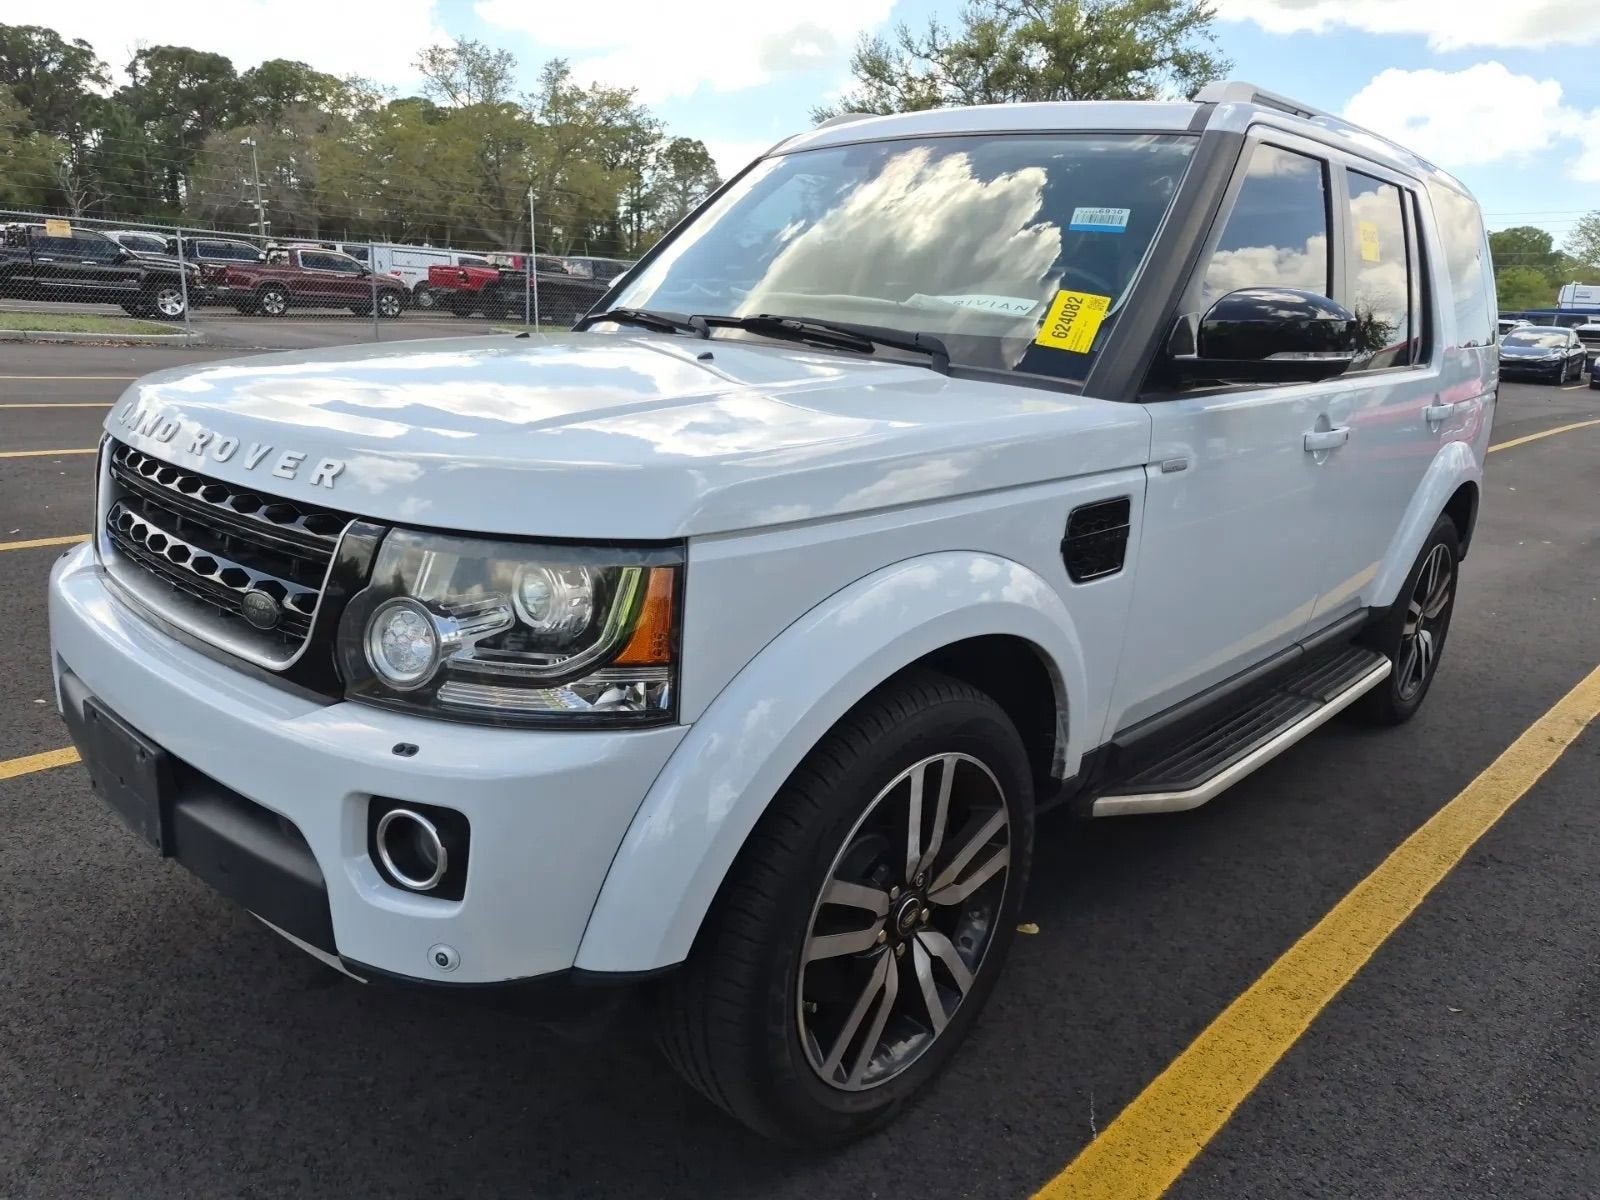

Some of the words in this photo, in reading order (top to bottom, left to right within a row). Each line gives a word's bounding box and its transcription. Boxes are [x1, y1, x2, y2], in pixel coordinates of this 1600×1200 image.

[1051, 296, 1084, 339] 624082
[119, 402, 181, 443] LAND
[187, 431, 345, 489] ROVER
